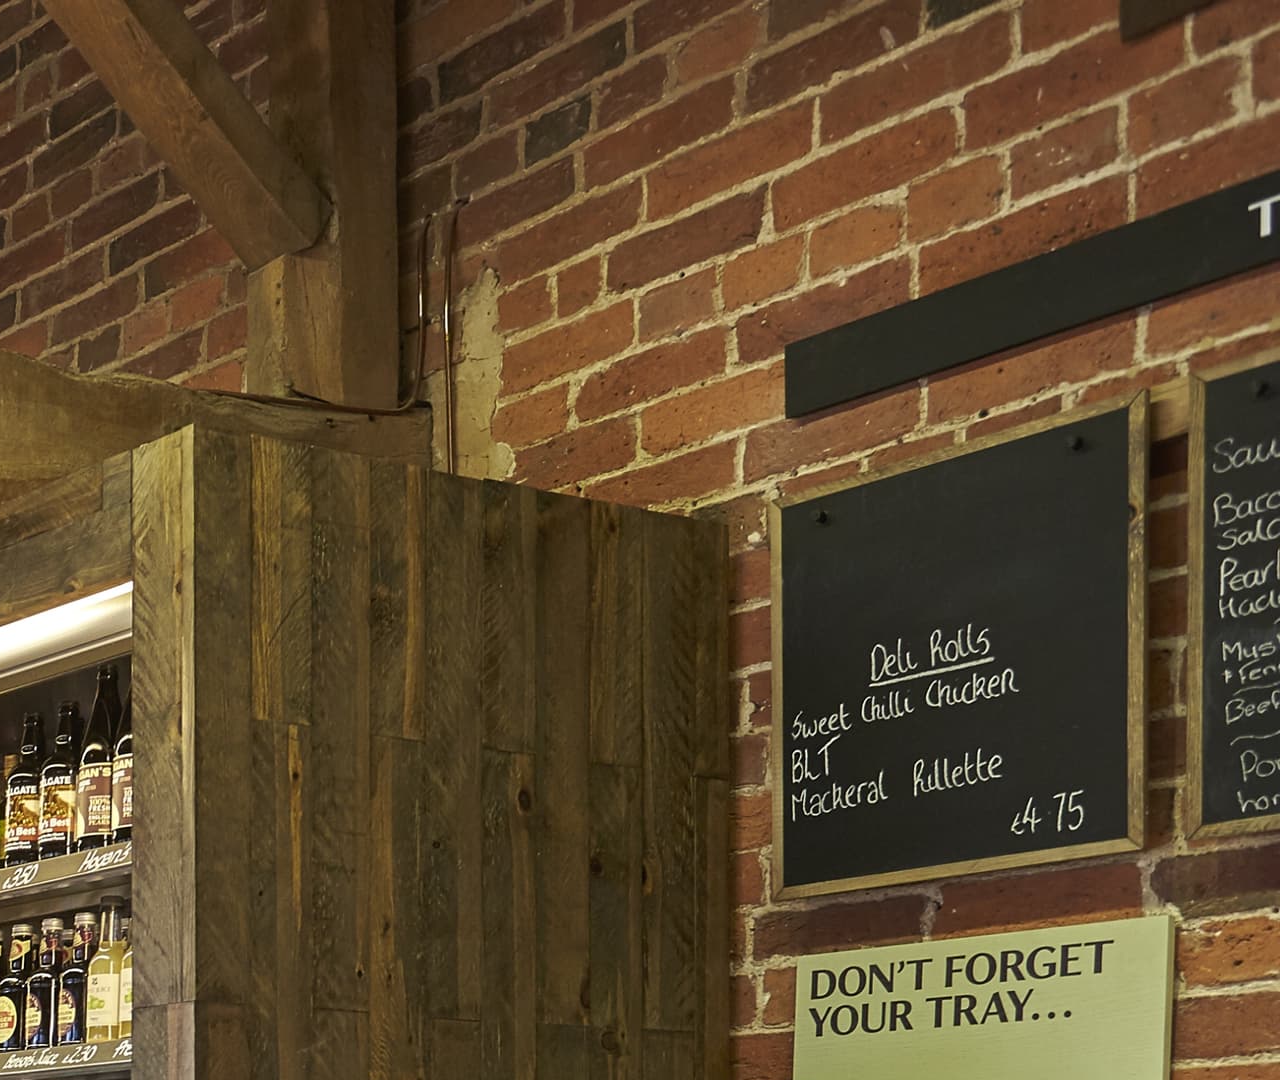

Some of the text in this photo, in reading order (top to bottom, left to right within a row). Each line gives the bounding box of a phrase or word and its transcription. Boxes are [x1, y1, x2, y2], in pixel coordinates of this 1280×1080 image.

[869, 622, 993, 683] Deli Rolls
[791, 667, 1020, 740] Sweet Chilli Chicken
[790, 733, 841, 785] BLT
[791, 770, 888, 822] Mackeral
[809, 938, 1115, 1001] DON'T FORGET
[808, 999, 914, 1037] YOUR
